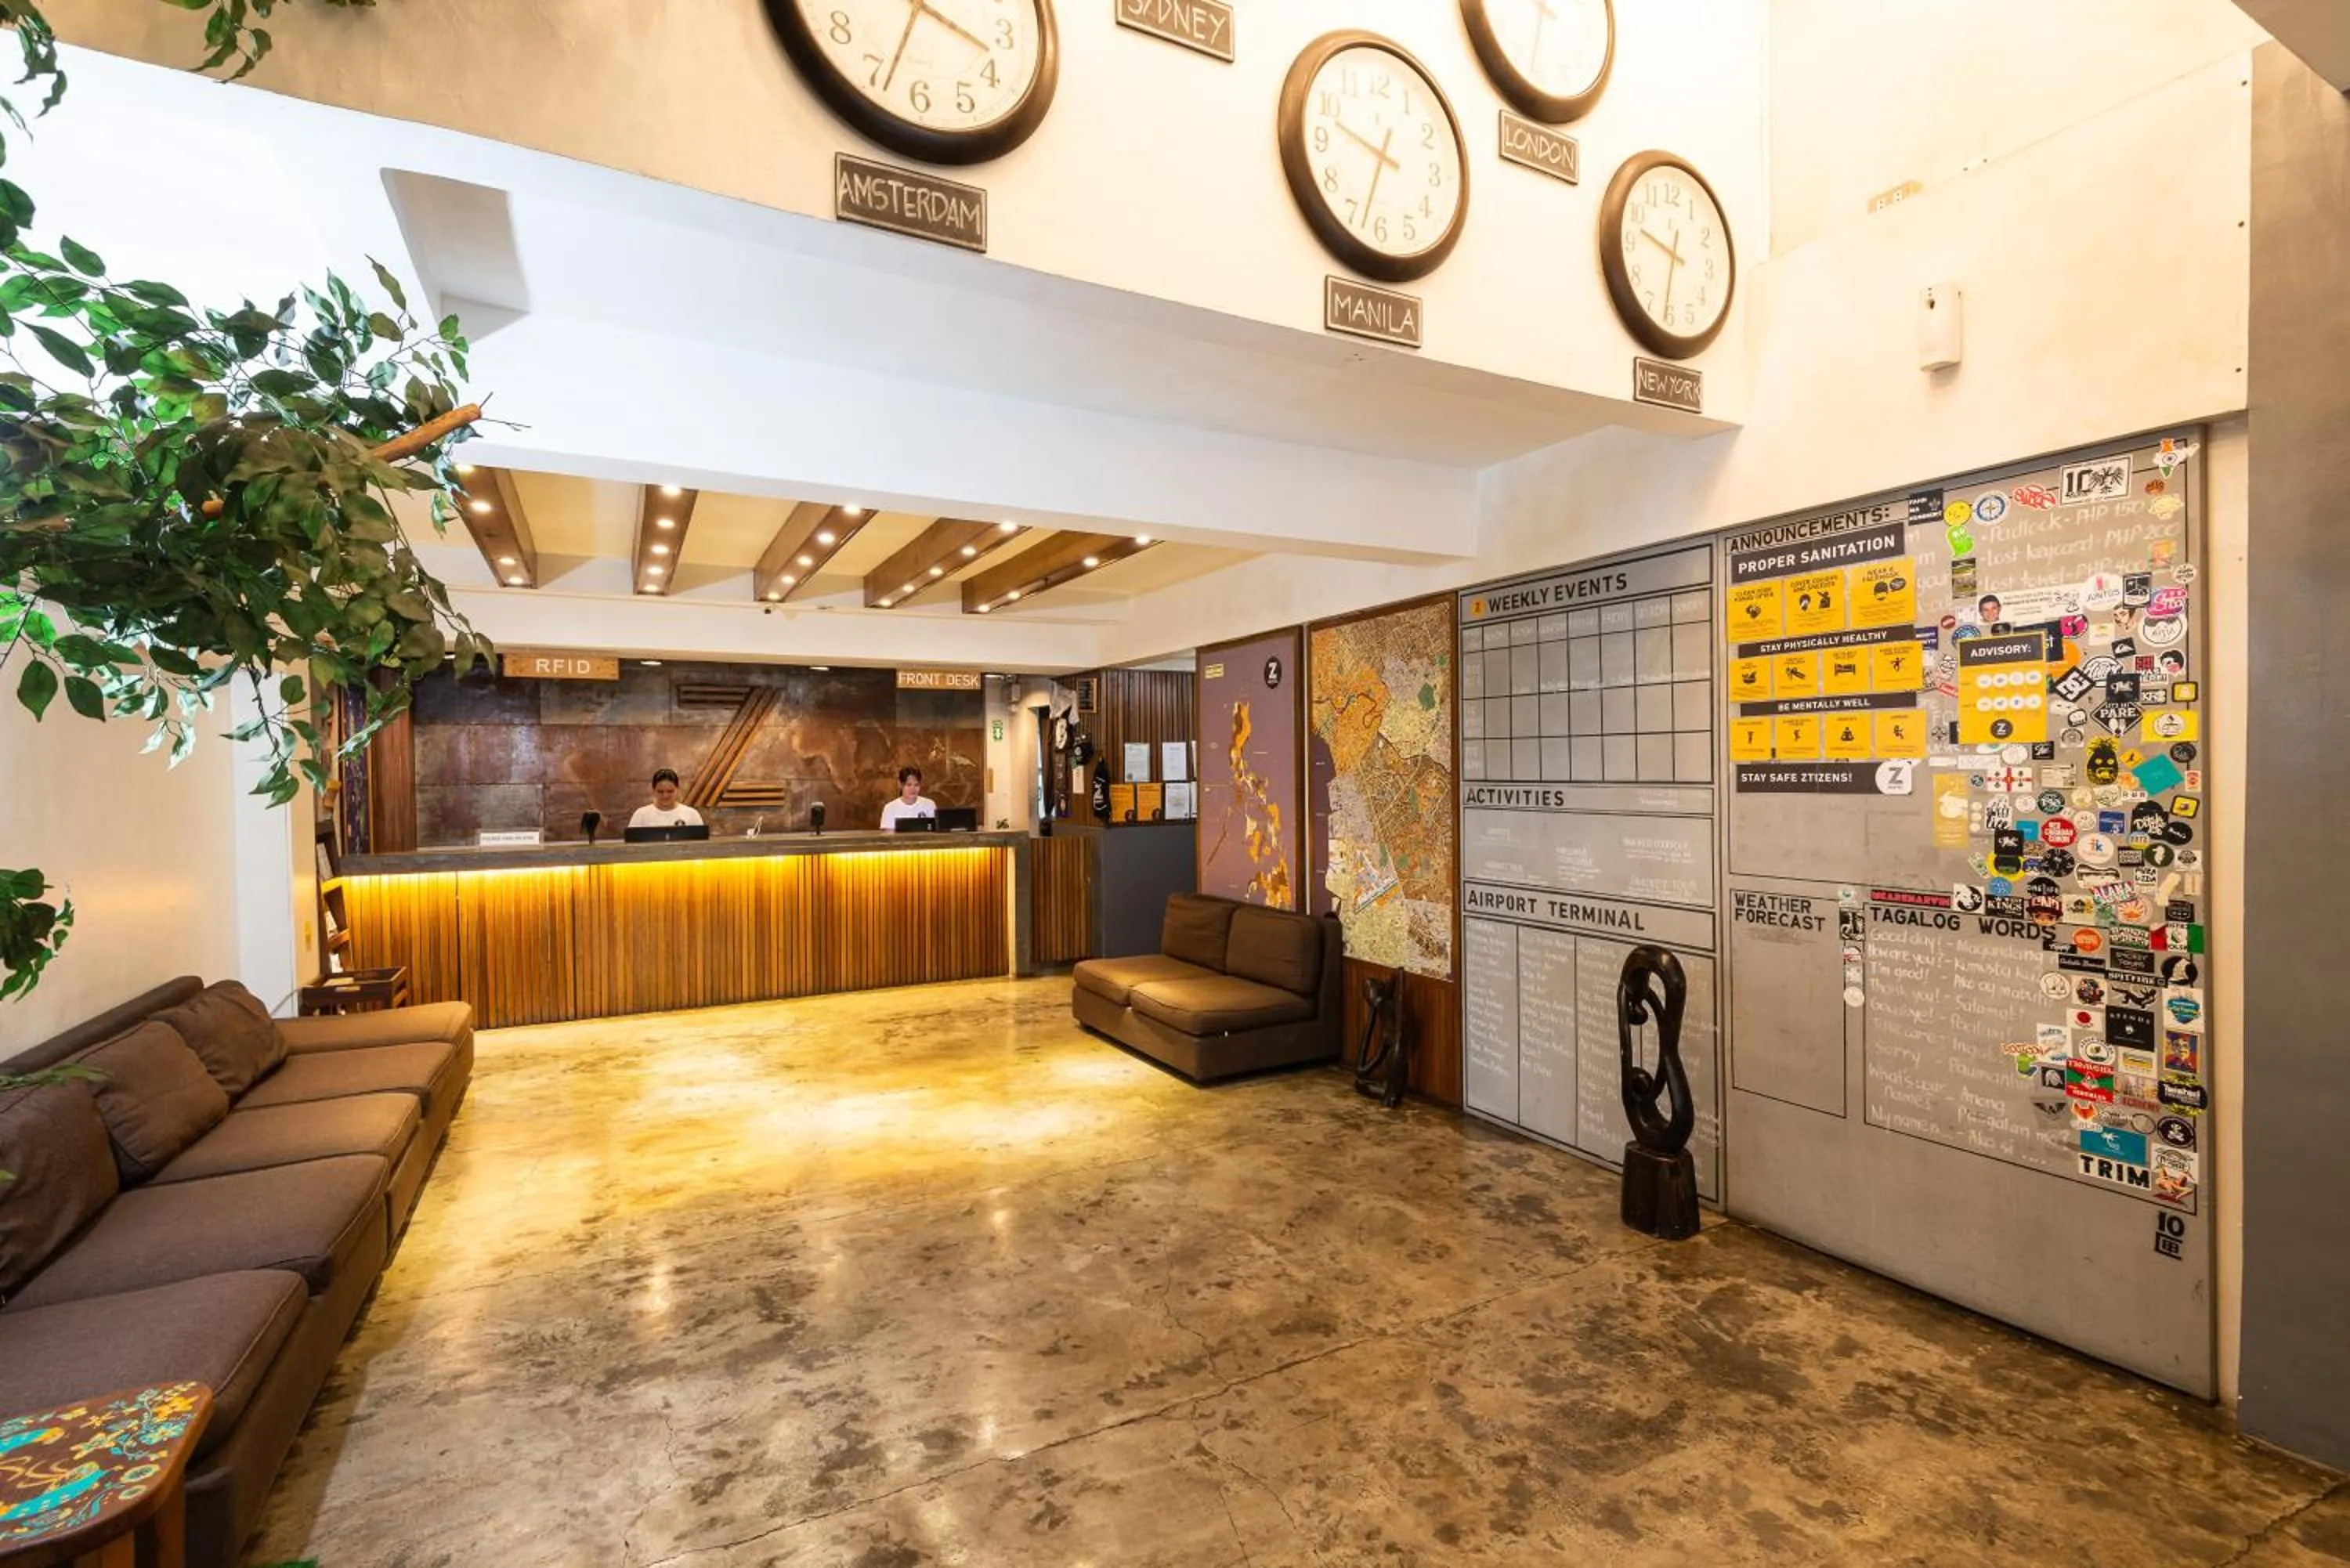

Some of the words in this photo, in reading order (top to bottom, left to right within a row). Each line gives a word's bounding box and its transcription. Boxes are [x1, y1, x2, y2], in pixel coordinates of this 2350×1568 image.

[830, 10, 851, 45] 8
[996, 18, 1014, 50] 3
[862, 53, 884, 87] 7
[980, 58, 1000, 89] 4
[1340, 68, 1359, 98] 11
[909, 80, 931, 114] 6
[956, 81, 975, 114] 5
[1369, 74, 1390, 99] 12
[1319, 90, 1341, 117] 10
[1403, 89, 1410, 115] 1
[1314, 125, 1329, 153] 9
[1421, 122, 1434, 150] 2
[1506, 125, 1574, 170] LONDON
[1324, 165, 1339, 193] 8
[1428, 161, 1441, 187] 3
[838, 171, 983, 237] AMSTERDAM
[1344, 198, 1359, 226] 7
[1419, 194, 1432, 219] 4
[1373, 215, 1388, 244] 6
[1403, 214, 1416, 240] 5
[1335, 293, 1415, 334] MANILA
[1640, 369, 1667, 395] NEW
[1669, 376, 1701, 403] YORK
[1730, 508, 1889, 551] ANNOUNCEMENTS:
[1738, 554, 1795, 574] PROPER
[1801, 534, 1895, 564] SANITATION
[1489, 587, 1549, 613] WEEKLY
[1555, 573, 1628, 601] EVENTS
[1760, 640, 1782, 653] STAY
[1783, 635, 1841, 650] PHYSICALLY
[1842, 631, 1888, 645] HEALTHY
[1971, 644, 2031, 658] ADVISORY:
[536, 658, 591, 674] RFID
[898, 672, 939, 685] FRONT
[946, 674, 978, 687] DESK
[1778, 703, 1790, 712] BE
[1791, 699, 1840, 710] MENTALLY
[1843, 698, 1871, 707] WELL
[1741, 774, 1766, 783] STAY
[1770, 773, 1798, 782] SAFE
[1801, 773, 1853, 782] ZTIZENS!
[1889, 767, 1904, 784] Z
[1466, 788, 1565, 807] ACTIVITIES
[1468, 890, 1538, 914] AIRPORT
[1549, 901, 1645, 931] TERMINAL
[1735, 893, 1812, 913] WEATHER
[1735, 908, 1826, 932] FORECAST
[1870, 907, 1960, 931] TAGALOG
[1979, 917, 2056, 941] WORDS
[2079, 1154, 2150, 1188] TRIM
